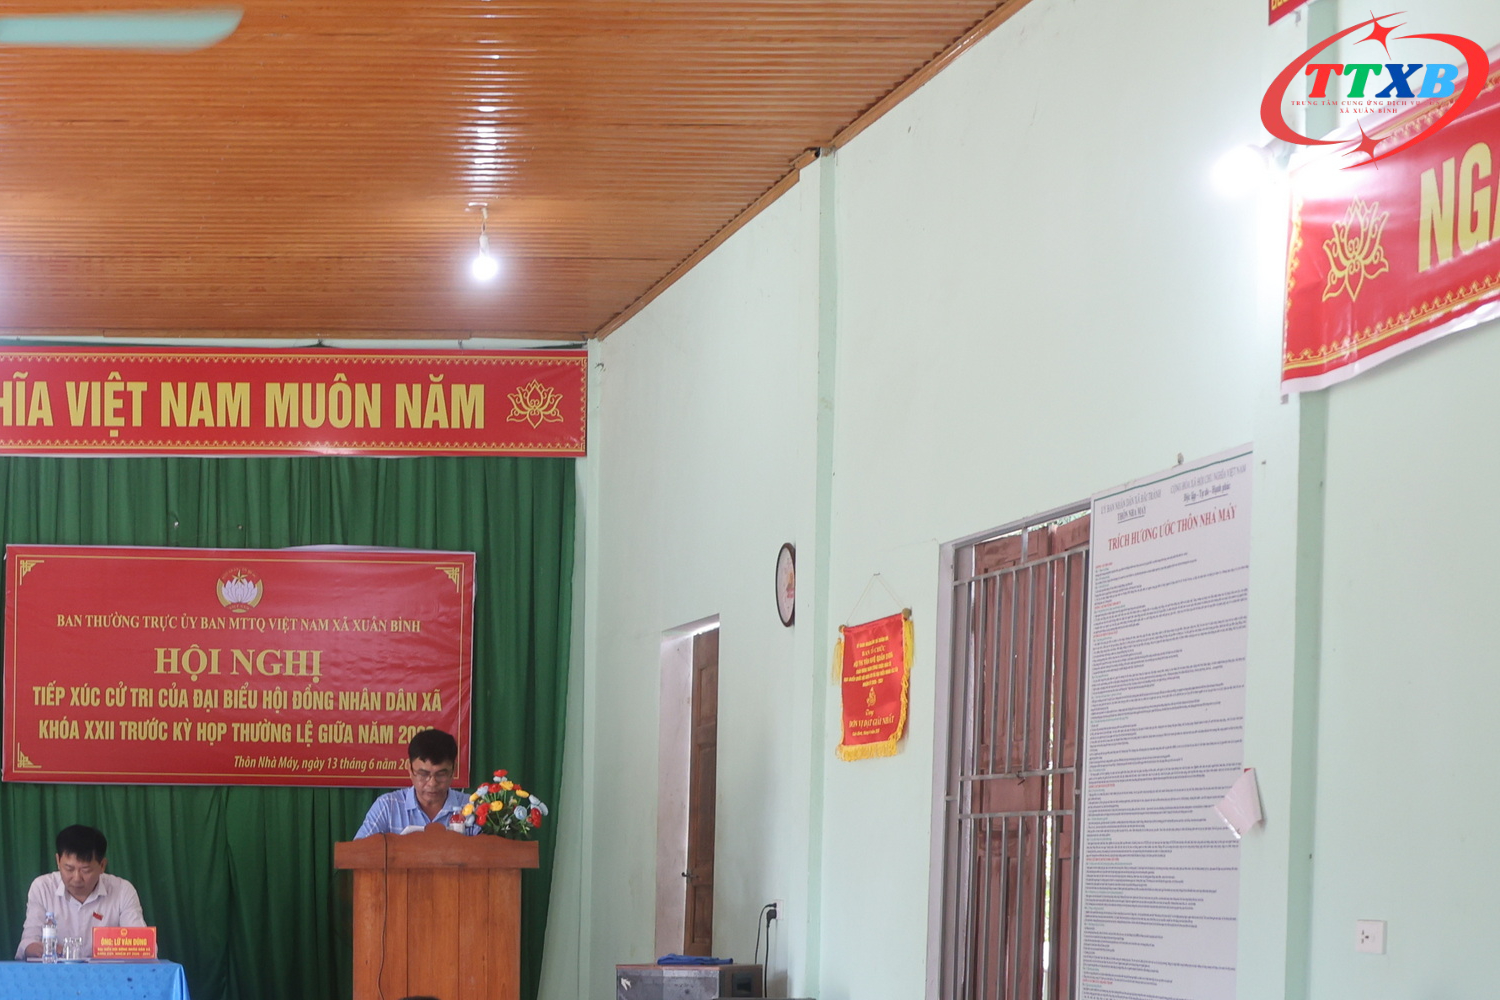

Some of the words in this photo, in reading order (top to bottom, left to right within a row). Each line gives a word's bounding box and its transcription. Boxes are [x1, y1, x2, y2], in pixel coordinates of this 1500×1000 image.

[65, 371, 148, 437] VIỆT
[161, 380, 251, 428] NAM
[265, 373, 381, 429] MUÔN
[395, 374, 485, 430] NĂM
[1108, 533, 1130, 551] TRÍCH
[1131, 526, 1157, 544] HƯƠNG
[1177, 513, 1198, 533] THÔN
[1218, 502, 1237, 522] MÁY
[57, 614, 82, 627] BAN
[85, 611, 139, 628] THƯỜNG
[143, 614, 178, 631] TRỰC
[181, 613, 198, 629] ỦY
[201, 617, 225, 630] BAN
[229, 617, 266, 633] MTTQ
[269, 616, 298, 634] VIỆT
[300, 618, 329, 631] NAM
[332, 616, 349, 632] XÃ
[352, 615, 387, 632] XUÂN
[390, 616, 421, 633] BÌNH
[154, 644, 221, 682] HỘI
[230, 649, 323, 684] NGHỊ
[33, 680, 65, 706] TIẾP
[70, 683, 101, 707] XÚC
[105, 681, 127, 707] CỬ
[130, 687, 153, 708] TRI
[158, 682, 189, 708] CỦA
[193, 689, 218, 713] ĐẠI
[223, 682, 258, 709] BIỂU
[263, 686, 287, 713] HỘI
[292, 684, 334, 710] ĐỒNG
[338, 687, 381, 711] NHÂN
[385, 688, 417, 711] DÂN
[421, 689, 442, 712] XÃ
[39, 716, 80, 740] KHÓA
[84, 720, 115, 740] XXII
[119, 717, 168, 741] TRƯỚC
[173, 718, 192, 741] KỲ
[197, 722, 227, 746] HỌP
[232, 719, 291, 743] THƯỜNG
[296, 720, 314, 747] LỆ
[318, 721, 354, 743] GIỮA
[358, 721, 393, 744] NĂM
[398, 725, 435, 744] 20
[234, 755, 257, 768] Thôn
[258, 756, 276, 769] Nhà
[278, 756, 299, 772] Máy,
[302, 757, 325, 772] ngày
[327, 758, 338, 769] 13
[340, 757, 367, 772] tháng
[369, 758, 375, 769] 6
[376, 758, 397, 770] năm
